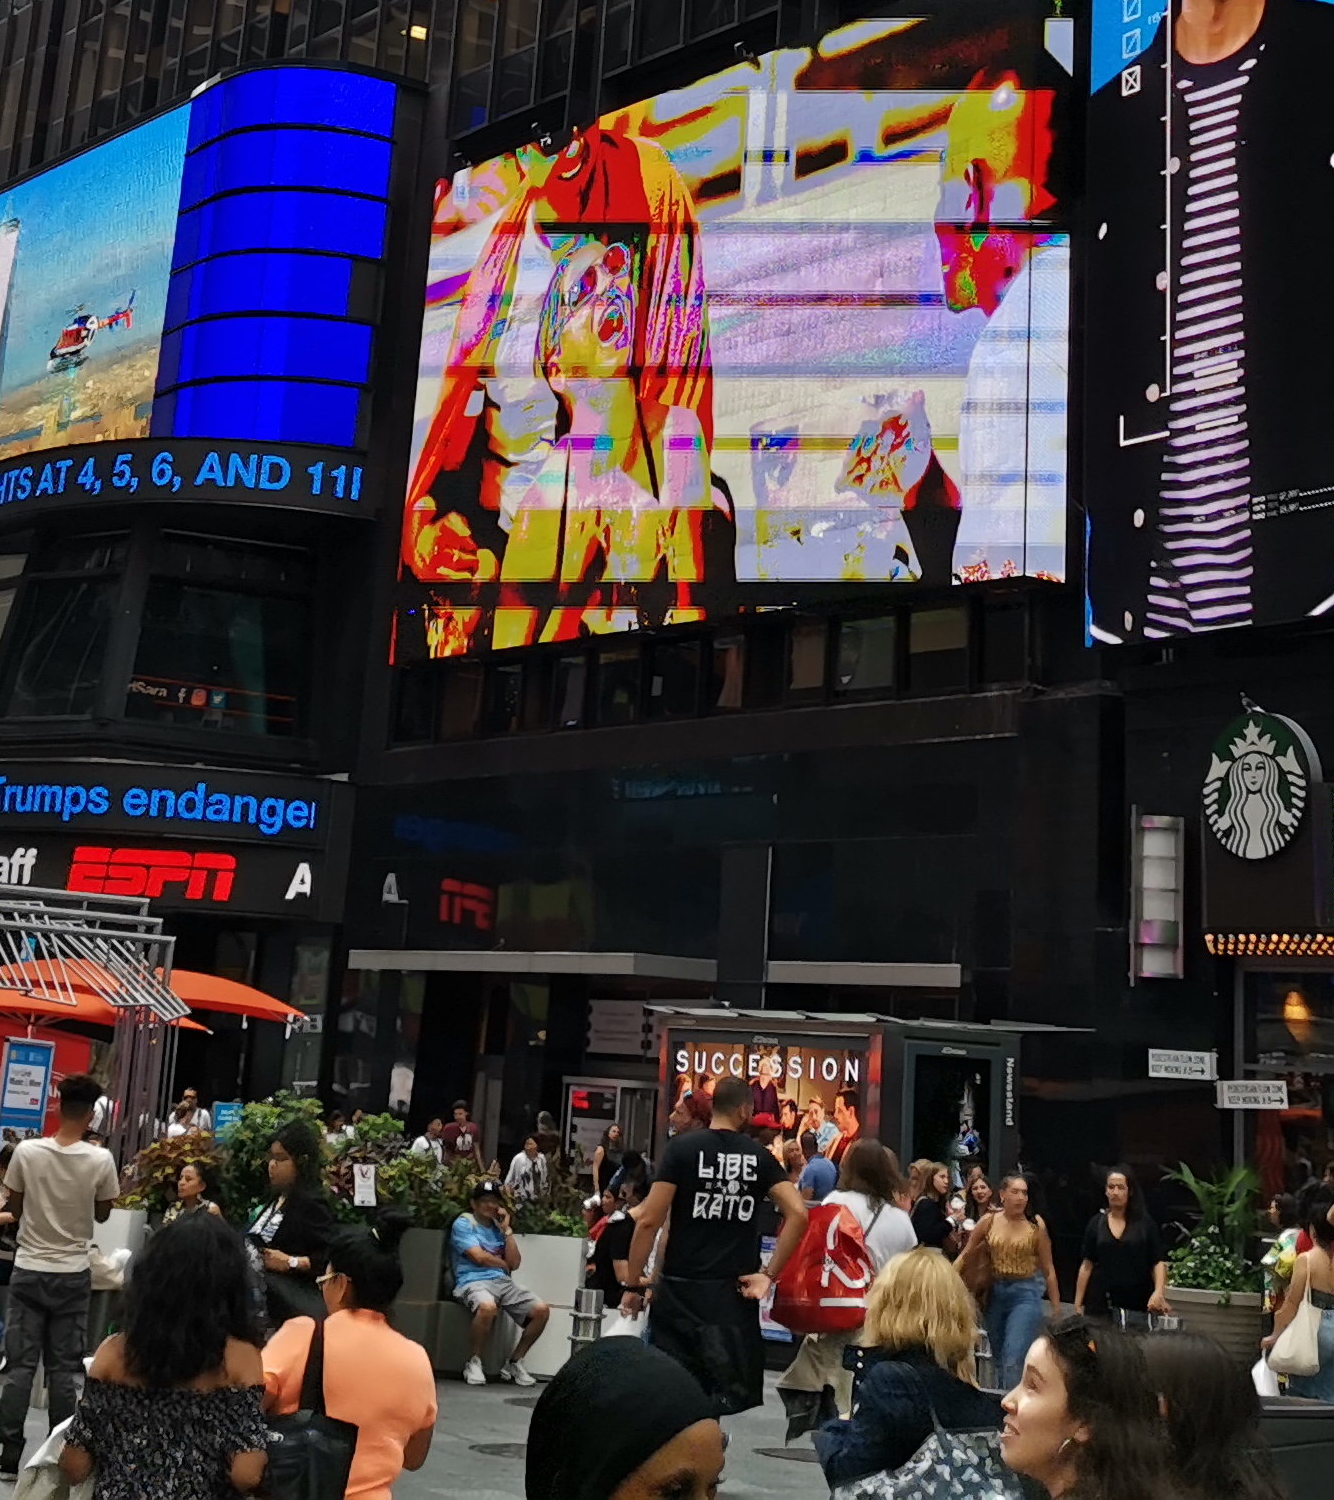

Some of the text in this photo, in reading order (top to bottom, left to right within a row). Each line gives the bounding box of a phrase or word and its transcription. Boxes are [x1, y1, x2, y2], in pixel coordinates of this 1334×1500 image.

[35, 458, 74, 497] AT
[75, 456, 102, 496] 4,
[111, 453, 139, 495] 5,
[150, 451, 183, 494] 6,
[193, 453, 291, 492] AND
[67, 845, 236, 902] ESPN
[675, 1049, 860, 1082] SUCCESSION
[1005, 1057, 1015, 1127] Newsstand
